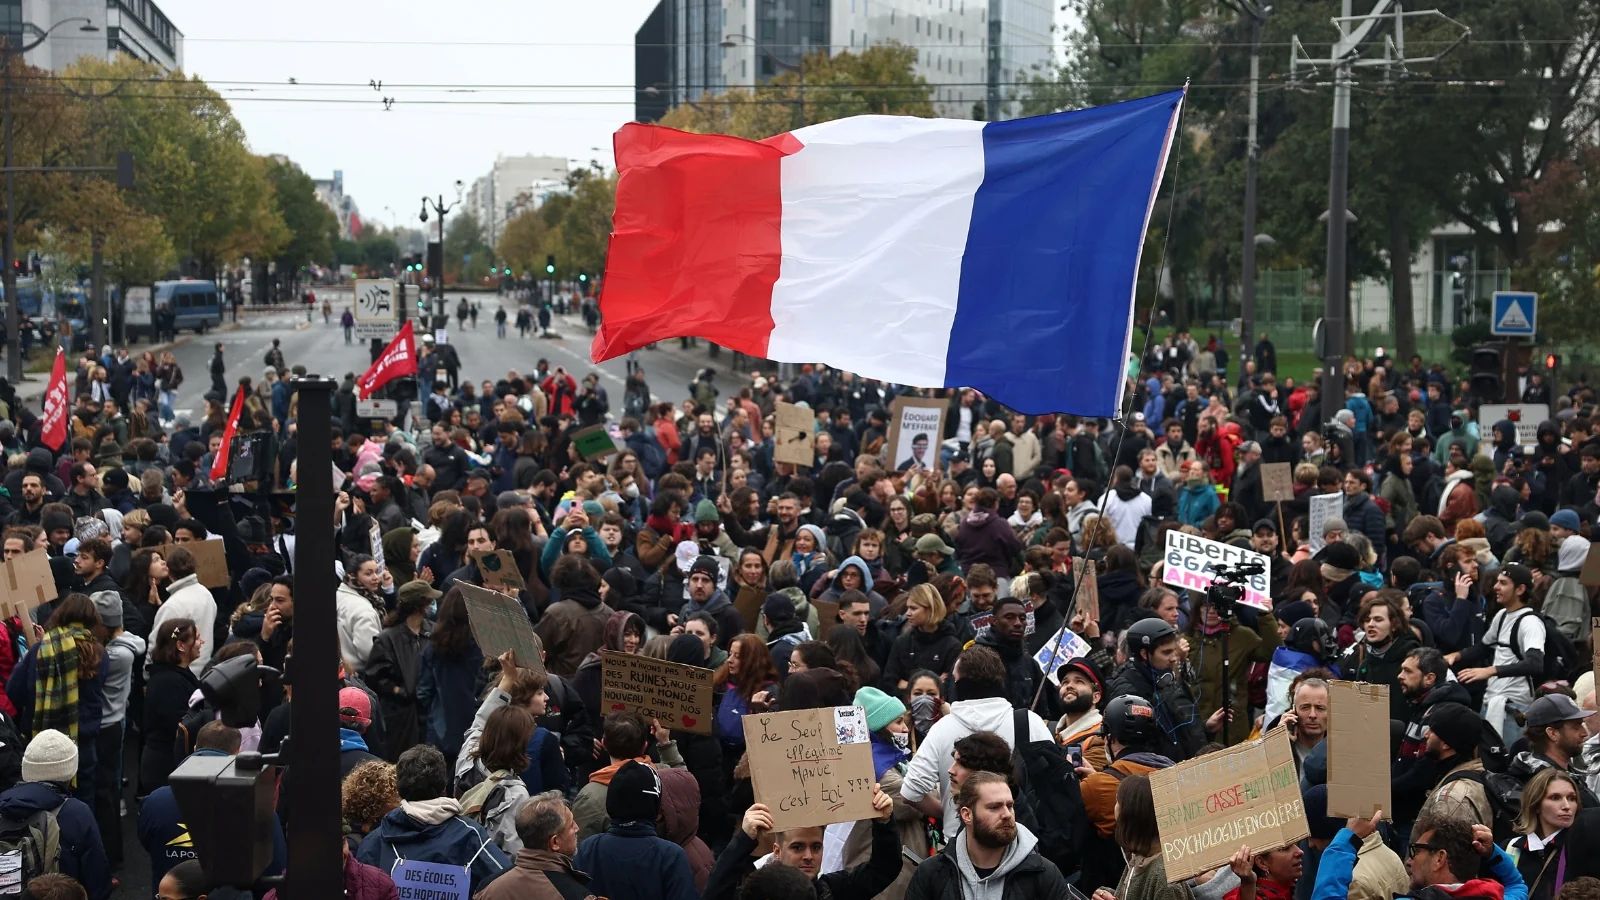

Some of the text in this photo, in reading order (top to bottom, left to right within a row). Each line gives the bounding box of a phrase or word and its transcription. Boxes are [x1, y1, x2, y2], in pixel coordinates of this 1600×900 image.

[1167, 549, 1266, 591] éGAé
[605, 659, 627, 668] NOUS
[665, 667, 679, 676] PAS
[686, 670, 707, 680] PEUR
[605, 680, 641, 692] PORTONS
[658, 689, 695, 703] MONDE
[606, 670, 622, 679] DES
[671, 680, 697, 692] NOUS
[604, 691, 701, 715] NOUVEAU DANS NOS
[760, 718, 822, 743] Le Seul
[821, 783, 843, 803] toi
[1205, 784, 1244, 813] CASSE
[1164, 818, 1245, 861] PSYCHOLOGUE
[165, 850, 178, 858] LA
[405, 869, 456, 888] DES ÉCOLES,
[414, 888, 460, 900] HOPITAUX
